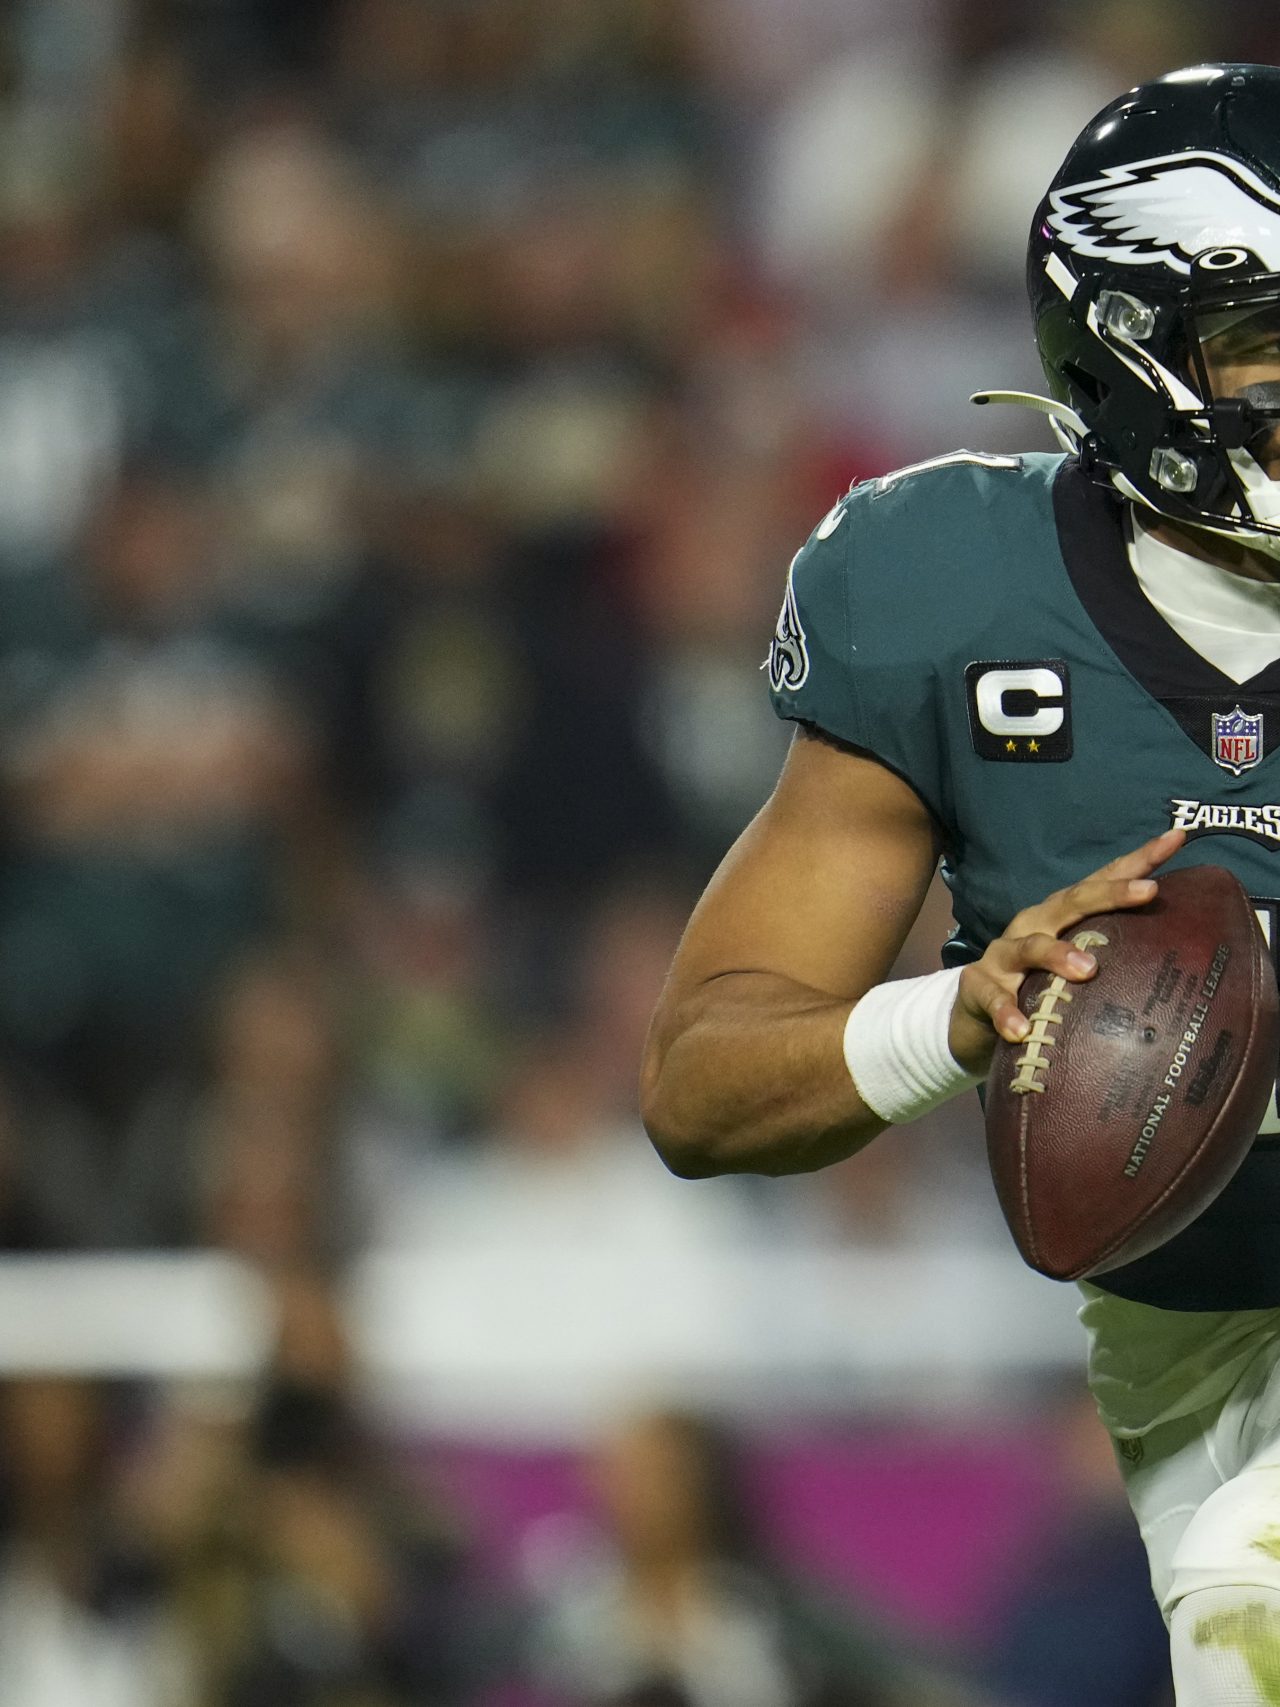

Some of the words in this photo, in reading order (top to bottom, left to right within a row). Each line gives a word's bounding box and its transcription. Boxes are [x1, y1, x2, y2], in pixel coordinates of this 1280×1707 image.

[976, 668, 1064, 736] C
[1219, 738, 1255, 762] NFL
[1123, 1092, 1171, 1179] NATIONAL
[1164, 1002, 1209, 1088] FOOTBALL
[1202, 943, 1231, 999] LEAGUE
